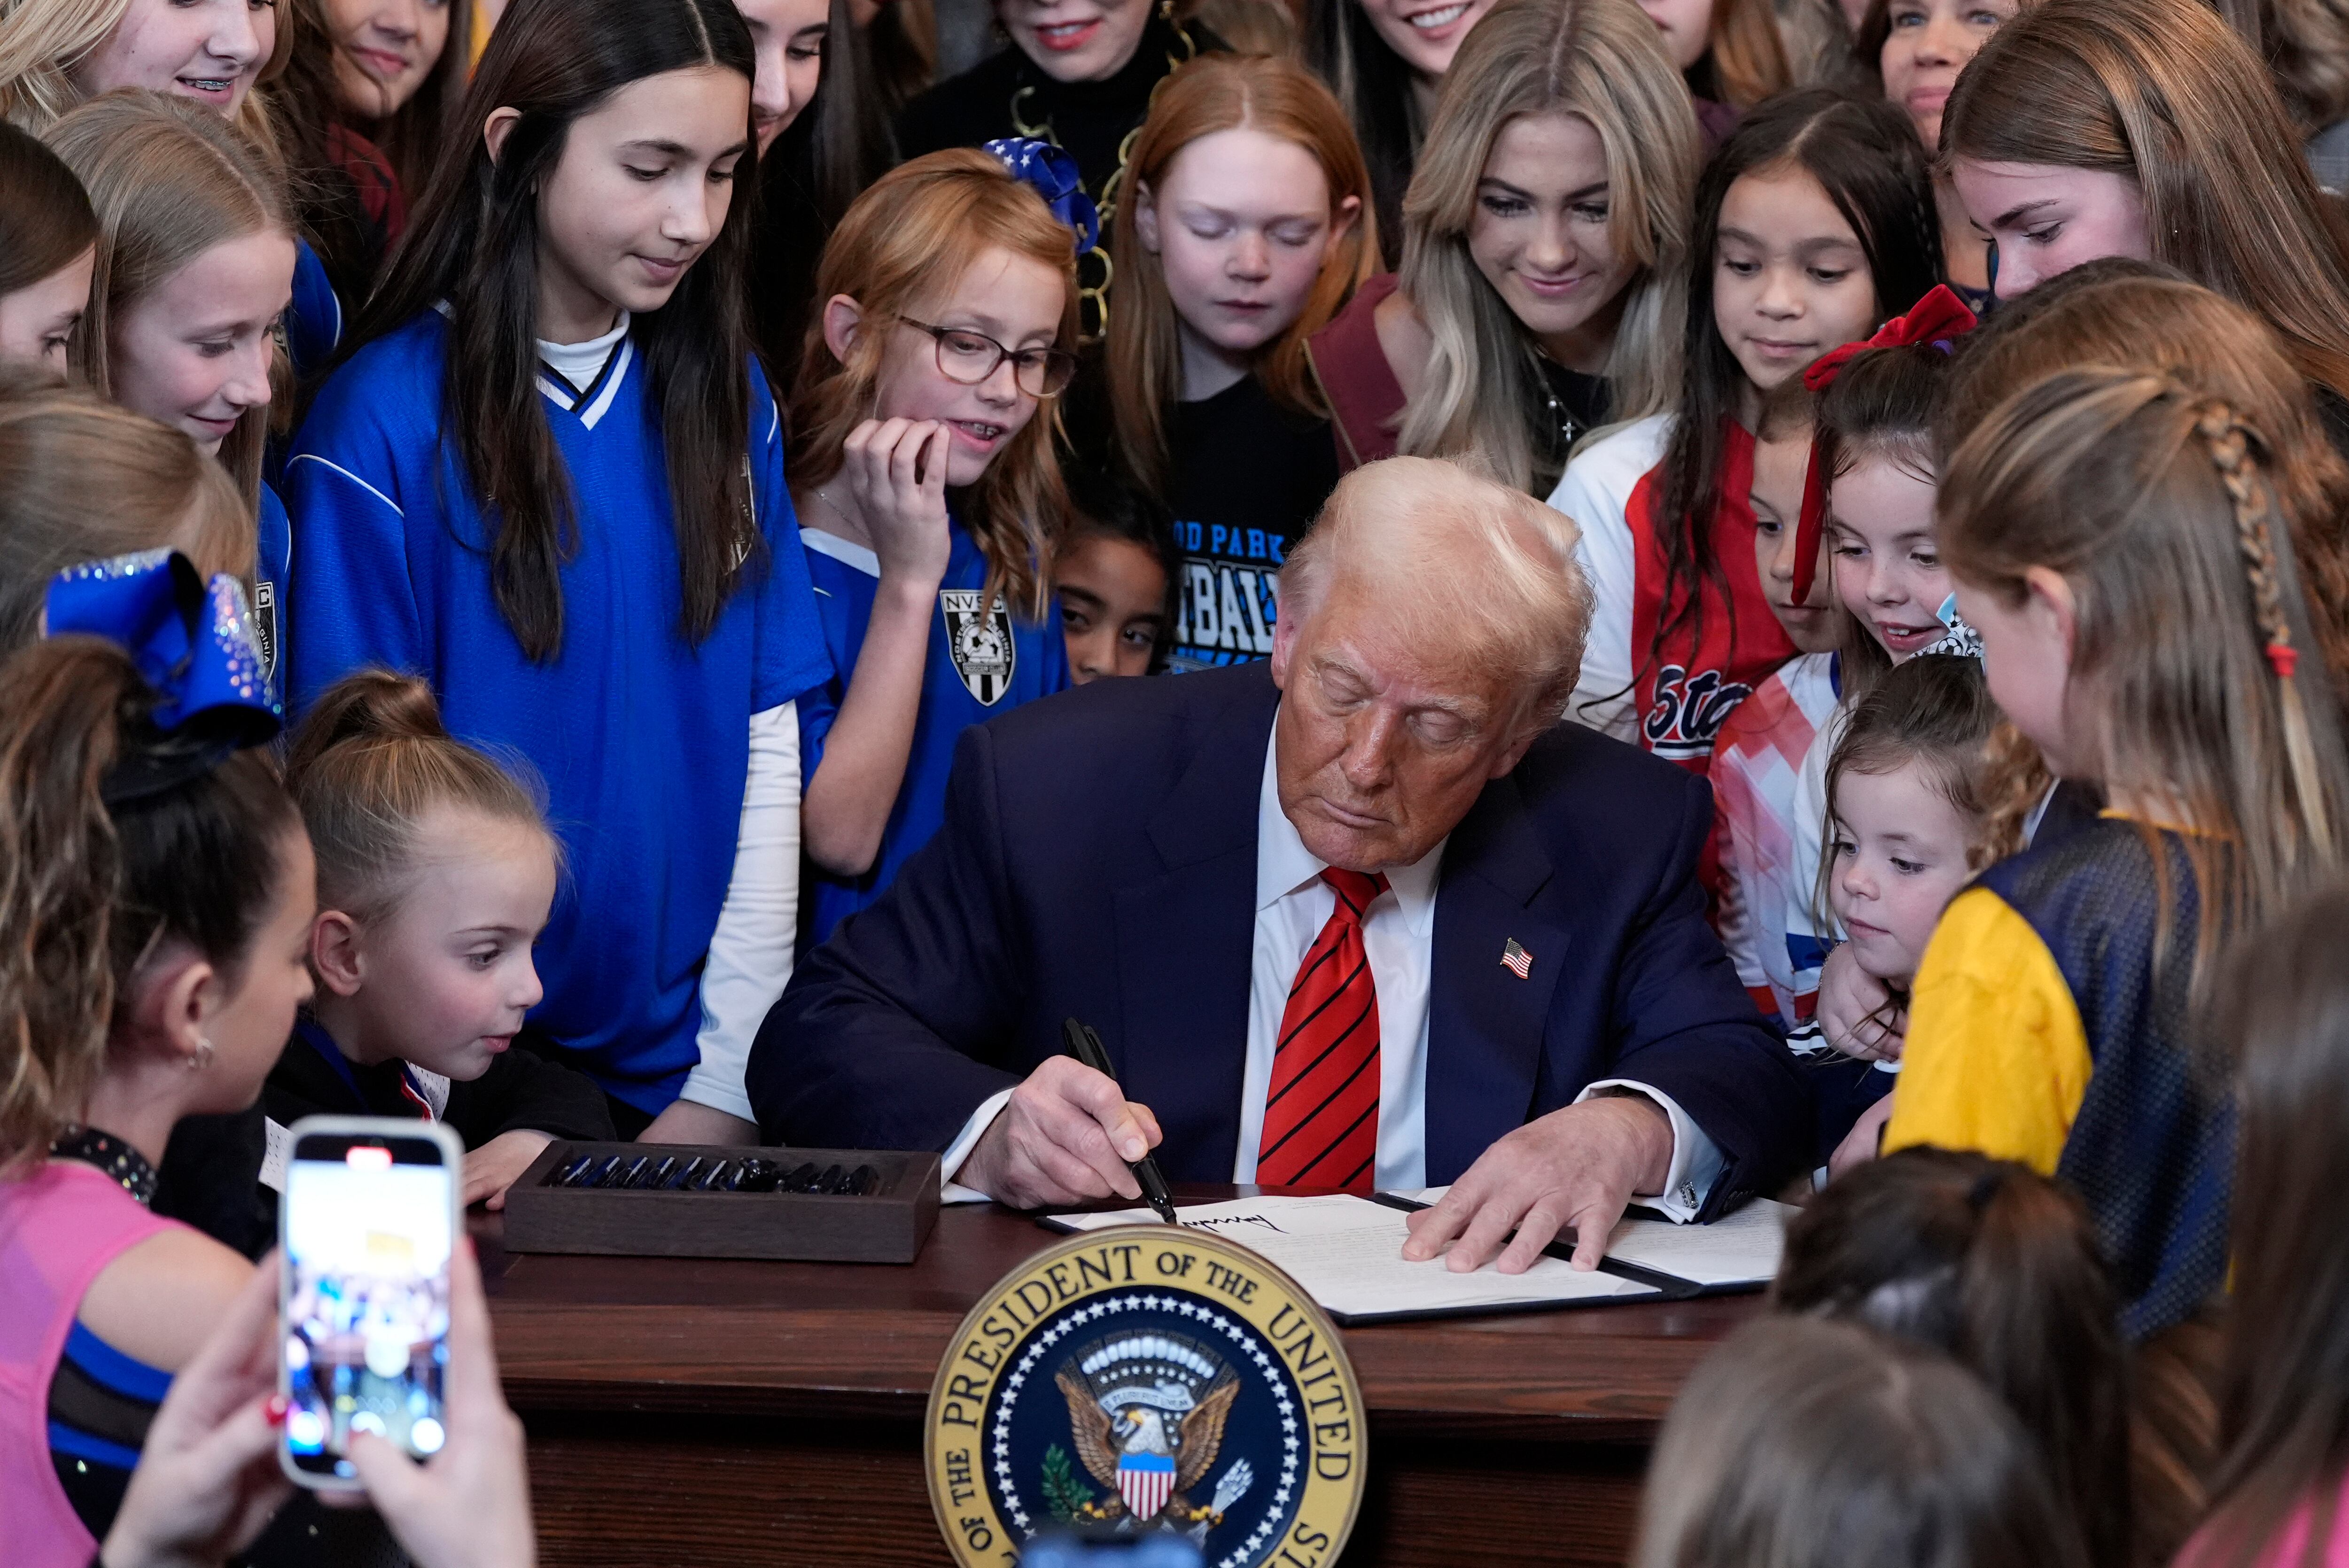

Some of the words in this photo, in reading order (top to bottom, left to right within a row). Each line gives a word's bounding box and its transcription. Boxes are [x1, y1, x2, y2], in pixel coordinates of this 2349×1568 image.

[1211, 524, 1284, 564] PARK
[1156, 1252, 1196, 1277] OF
[1206, 1261, 1258, 1305] THE
[941, 1245, 1141, 1429] PRESIDENT
[1269, 1303, 1352, 1481] UNITED
[947, 1447, 975, 1507] THE
[960, 1517, 992, 1551] OF
[1268, 1522, 1329, 1568] ST
